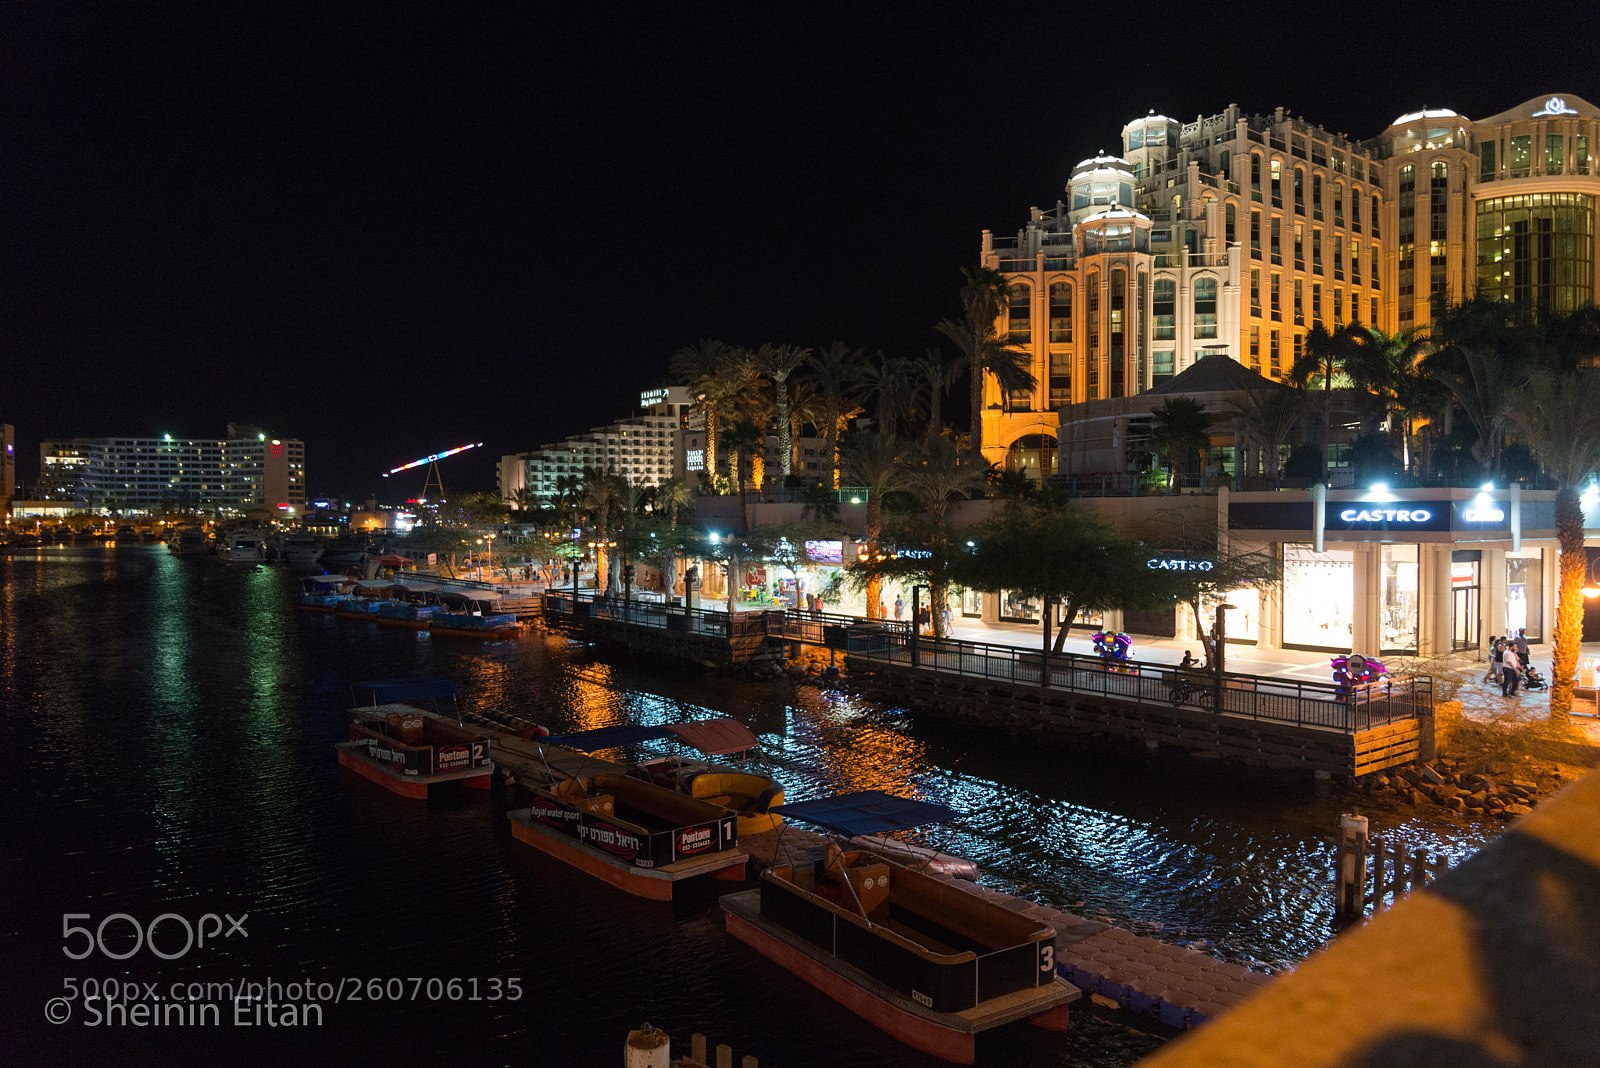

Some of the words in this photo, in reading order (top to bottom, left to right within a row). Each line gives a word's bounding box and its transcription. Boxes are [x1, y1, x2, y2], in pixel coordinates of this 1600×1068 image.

[1340, 509, 1432, 523] CASTRO
[1147, 558, 1214, 571] CASTRO
[439, 749, 470, 763] Pontoon
[474, 744, 484, 760] 2
[531, 806, 547, 818] Royal
[547, 808, 563, 817] water
[563, 811, 580, 821] sport
[589, 827, 615, 845] ספורט
[681, 829, 711, 845] Pontoon
[723, 821, 732, 840] 1
[615, 830, 640, 851] רויאל
[1040, 945, 1054, 972] 3
